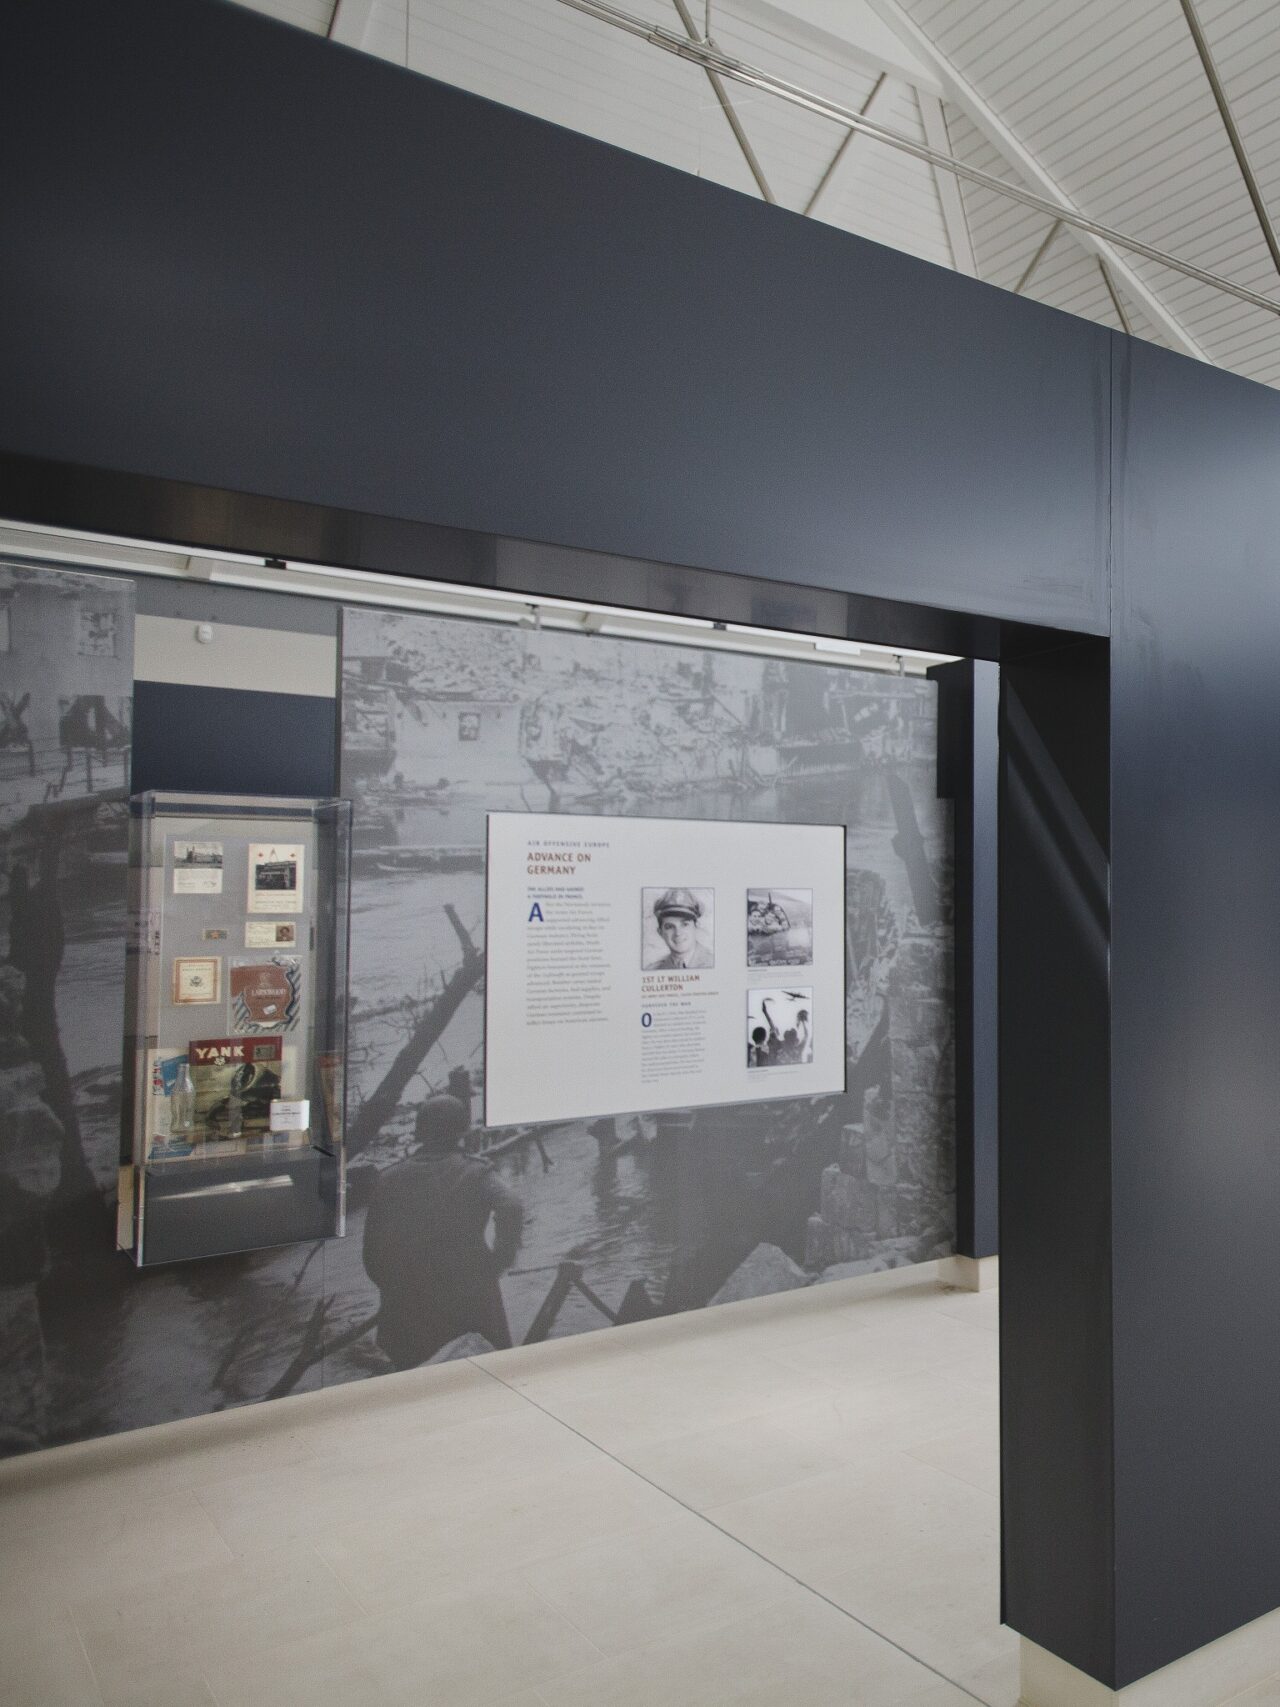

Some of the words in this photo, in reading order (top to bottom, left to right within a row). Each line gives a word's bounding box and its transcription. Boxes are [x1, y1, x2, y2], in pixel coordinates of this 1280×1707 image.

[527, 852, 574, 862] ADVANCE
[577, 853, 591, 862] ON
[527, 865, 576, 875] GERMANY
[641, 976, 655, 984] 1ST
[668, 974, 701, 983] WILLIAM
[641, 984, 684, 993] CULLERTON
[195, 1045, 245, 1059] YANK
